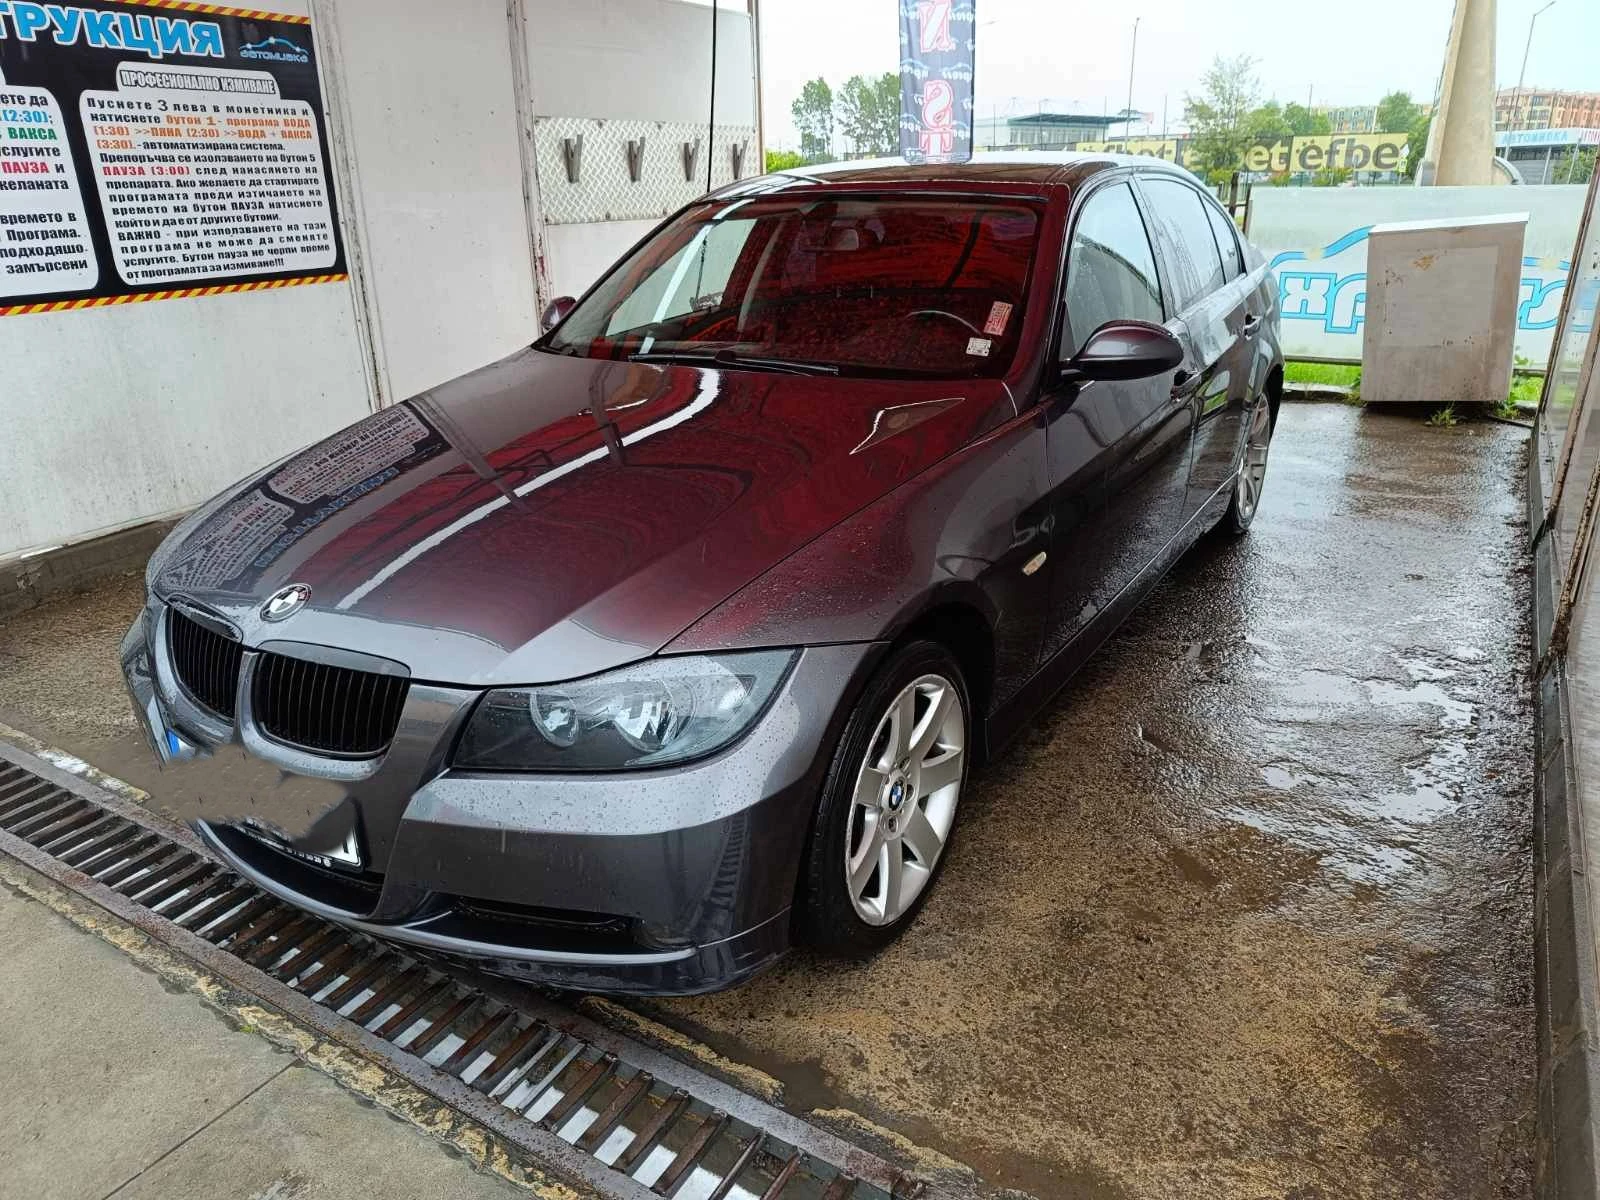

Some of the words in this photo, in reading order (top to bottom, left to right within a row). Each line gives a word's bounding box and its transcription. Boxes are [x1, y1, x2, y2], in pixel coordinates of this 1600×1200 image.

[120, 70, 220, 91] ПРОФЕСИОНАЛНО
[220, 76, 276, 94] ИЗМИВАНЕ
[29, 96, 48, 106] да
[87, 98, 152, 110] Пуснете
[158, 99, 168, 111] 3
[173, 103, 207, 112] лева
[226, 106, 296, 115] монетника
[302, 108, 308, 116] и
[91, 112, 160, 123] натиснете
[166, 115, 201, 124] бутон
[226, 118, 279, 127] програма
[283, 119, 310, 128] ВОДА
[8, 127, 57, 140] ВАКСА
[0, 146, 60, 157] слугите
[100, 153, 175, 164] Препоръчва
[280, 154, 307, 163] бутон
[2, 162, 49, 173] ПАУЗА
[55, 164, 65, 173] и
[103, 166, 145, 176] ПАУЗА
[196, 166, 228, 176] след
[233, 166, 300, 174] нанасянето
[305, 166, 317, 174] на
[176, 179, 196, 188] Ако
[198, 179, 246, 188] желаете
[249, 179, 262, 187] да
[265, 178, 319, 186] стартирате
[109, 192, 189, 202] програмата
[194, 191, 233, 201] преди
[238, 190, 304, 198] изтичането
[112, 206, 168, 216] времето
[173, 205, 188, 213] на
[193, 204, 226, 213] бутон
[231, 202, 264, 210] ПАУЗА
[269, 200, 323, 209] натиснете
[68, 213, 76, 221] в
[115, 219, 151, 228] който
[162, 219, 176, 227] да
[200, 215, 242, 225] другите
[6, 229, 81, 241] Програма.
[118, 230, 160, 240] ВАЖНО
[176, 230, 198, 238] при
[203, 225, 282, 236] използването
[303, 222, 326, 230] тази
[121, 242, 190, 254] програма
[196, 240, 212, 249] не
[218, 238, 253, 248] може
[259, 236, 273, 245] да
[182, 253, 214, 262] Бутон
[218, 251, 248, 260] пауза
[252, 249, 264, 257] не
[268, 247, 297, 256] черпи
[300, 244, 330, 253] време
[6, 260, 88, 274] замърсени
[127, 271, 140, 279] от
[142, 266, 208, 278] програмата
[209, 264, 221, 272] за
